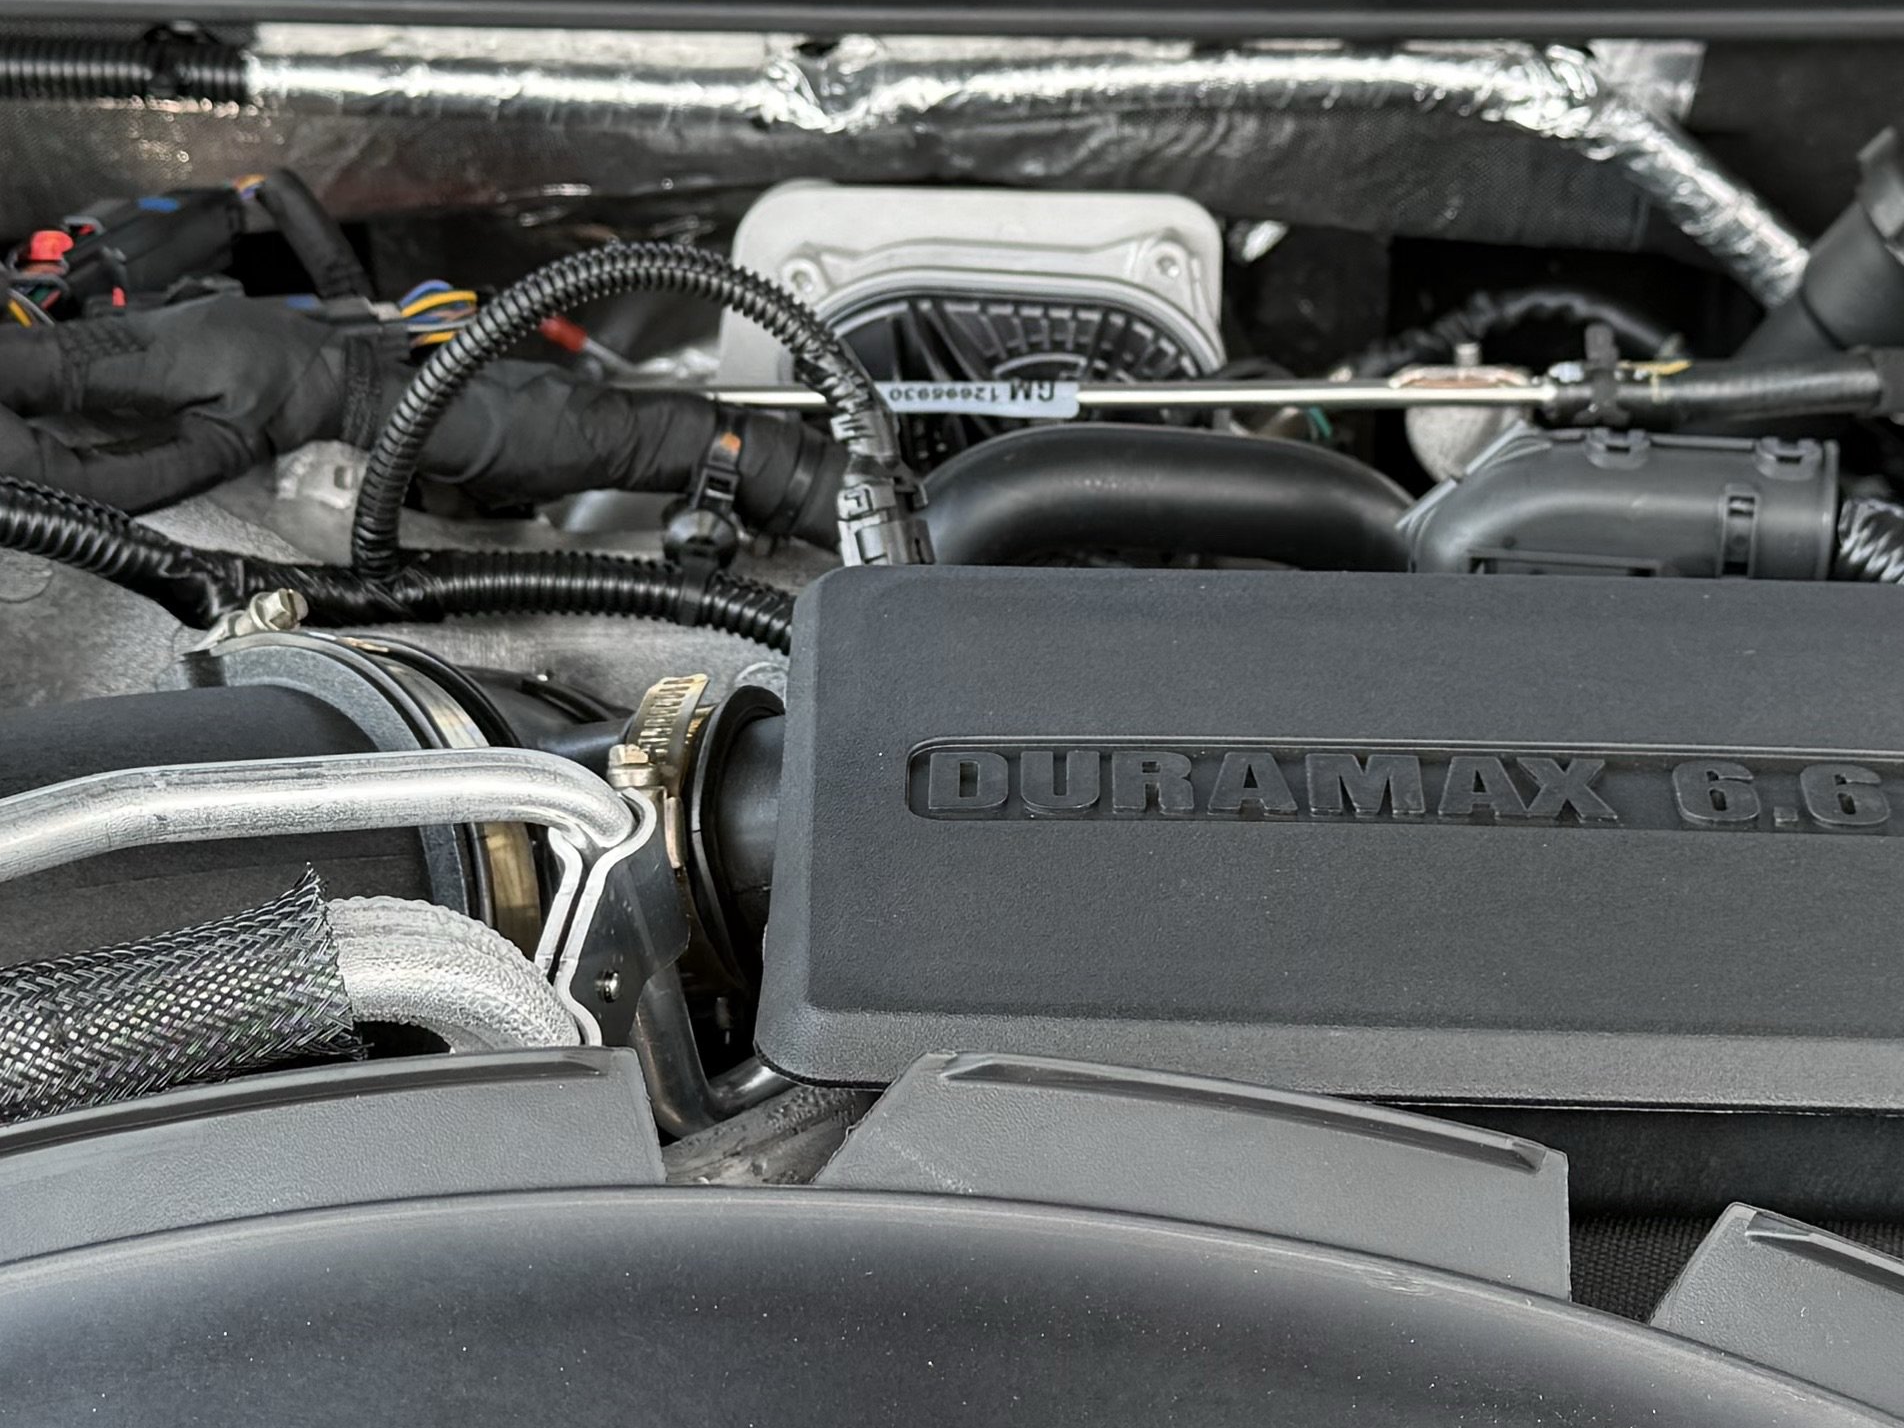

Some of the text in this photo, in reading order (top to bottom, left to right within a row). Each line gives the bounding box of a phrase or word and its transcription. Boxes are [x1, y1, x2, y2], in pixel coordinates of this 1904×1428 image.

[1010, 381, 1054, 402] GM
[925, 747, 1625, 824] DURAMAX
[1672, 758, 1890, 828] 6.6
